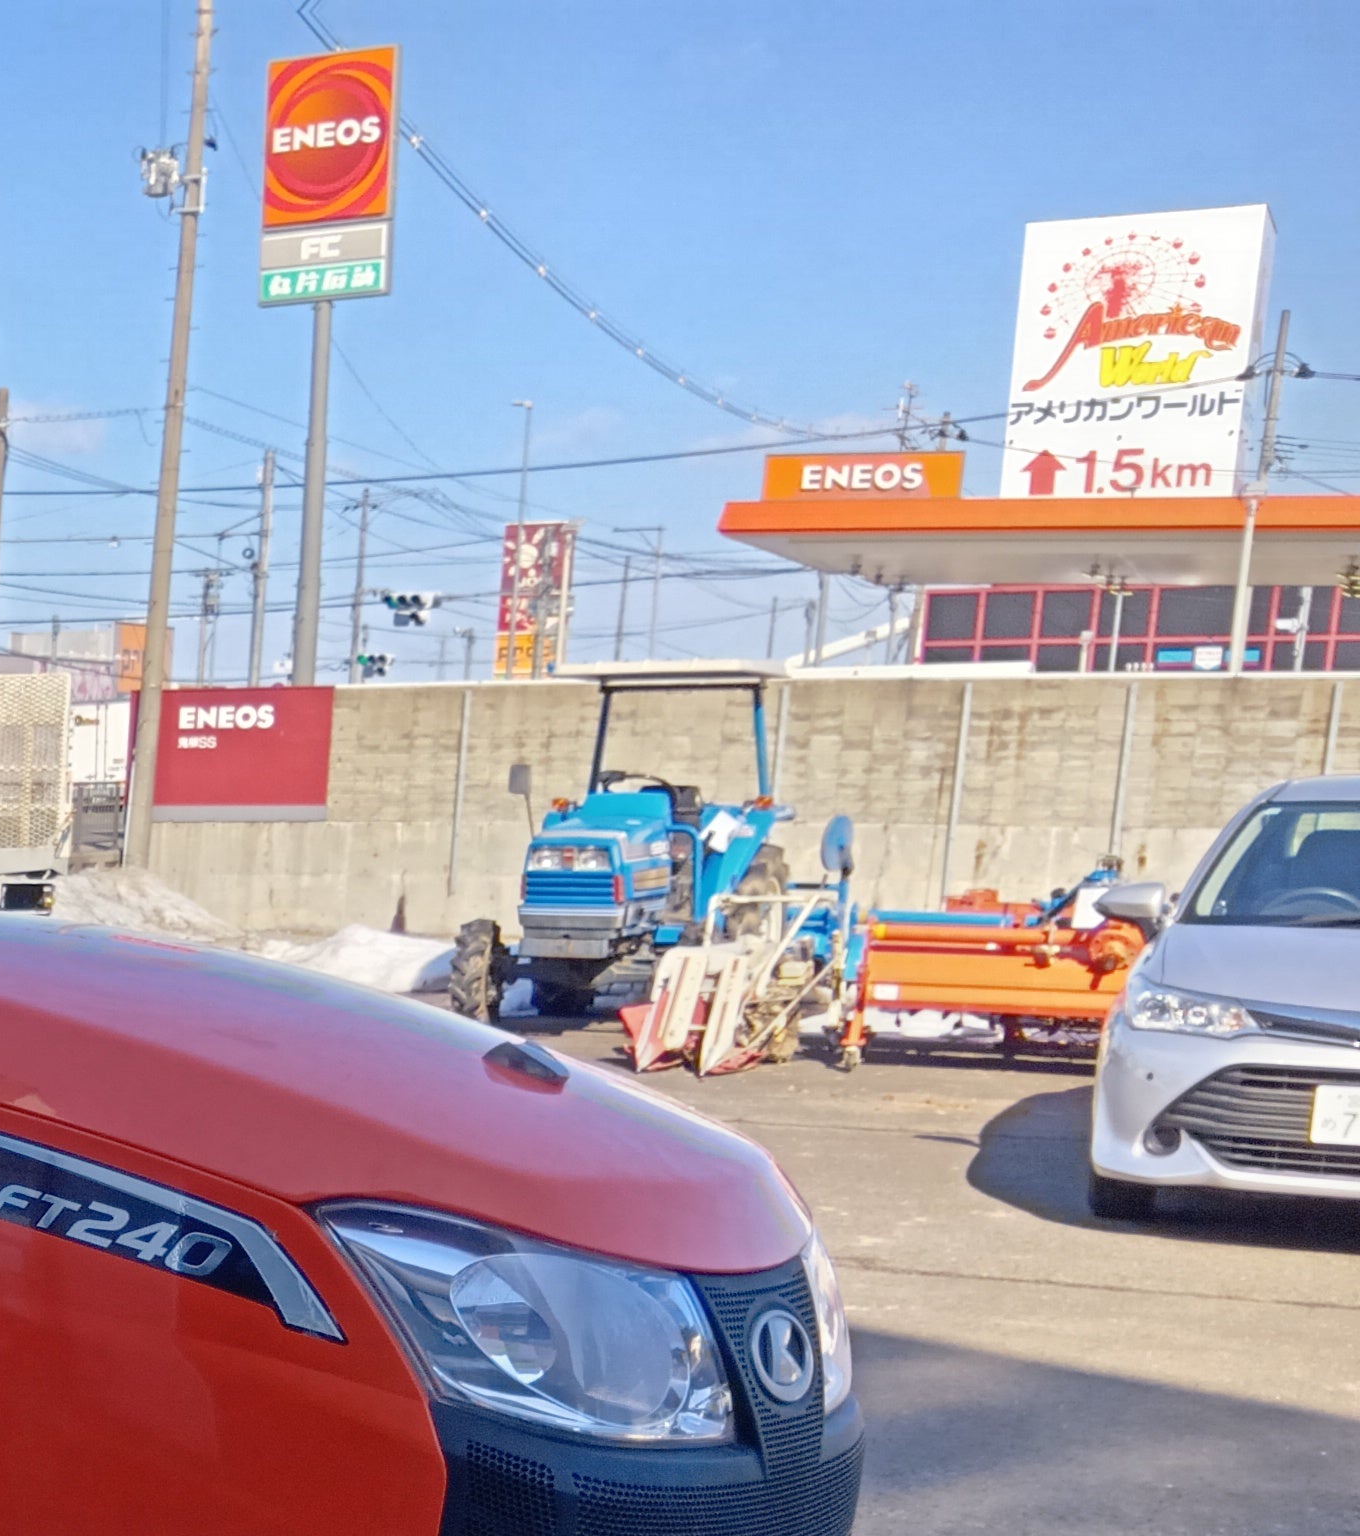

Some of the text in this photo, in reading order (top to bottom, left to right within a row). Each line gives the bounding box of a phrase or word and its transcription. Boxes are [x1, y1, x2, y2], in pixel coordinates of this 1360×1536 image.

[272, 116, 381, 154] ENEOS
[301, 235, 342, 260] FC
[1099, 341, 1213, 388] World
[1009, 389, 1243, 425] アメリカンワールド
[801, 462, 923, 490] ENEOS
[178, 705, 274, 729] ENEOS
